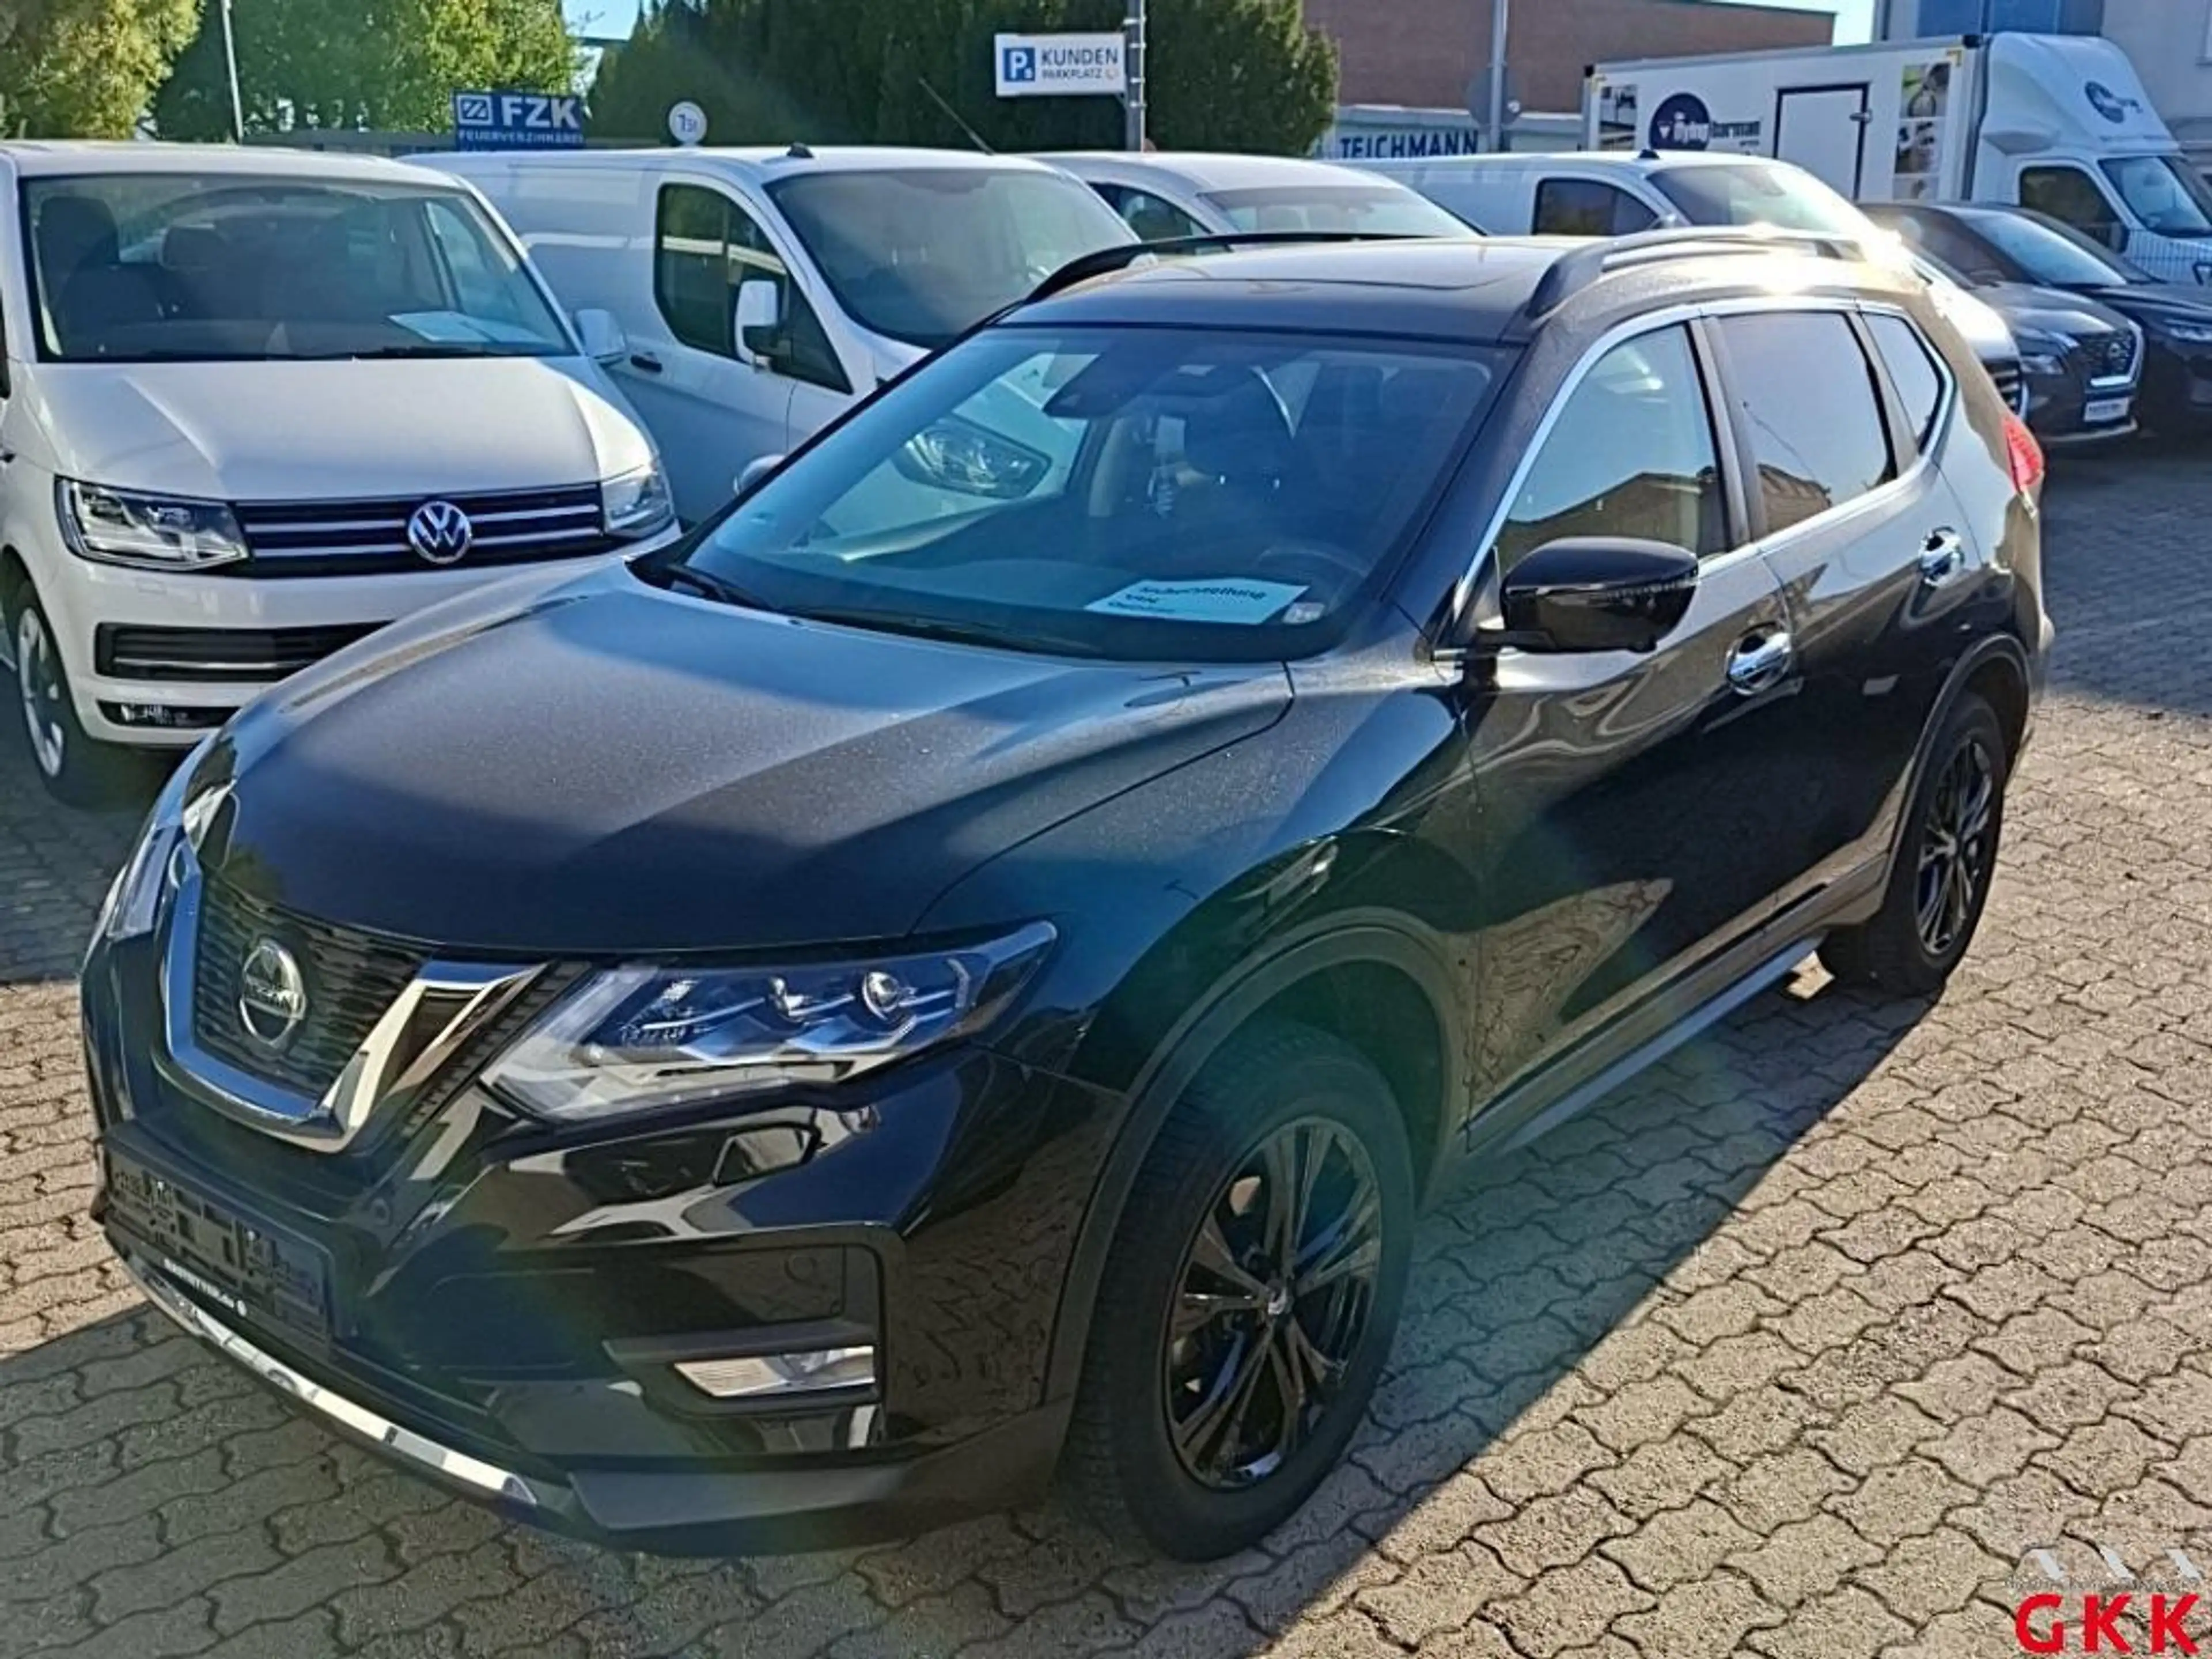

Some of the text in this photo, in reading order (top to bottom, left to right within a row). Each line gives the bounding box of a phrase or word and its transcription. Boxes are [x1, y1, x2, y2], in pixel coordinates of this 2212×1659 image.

[1041, 48, 1119, 66] KUNDEN
[501, 96, 580, 128] FZK
[1339, 129, 1479, 159] TEICHMANN
